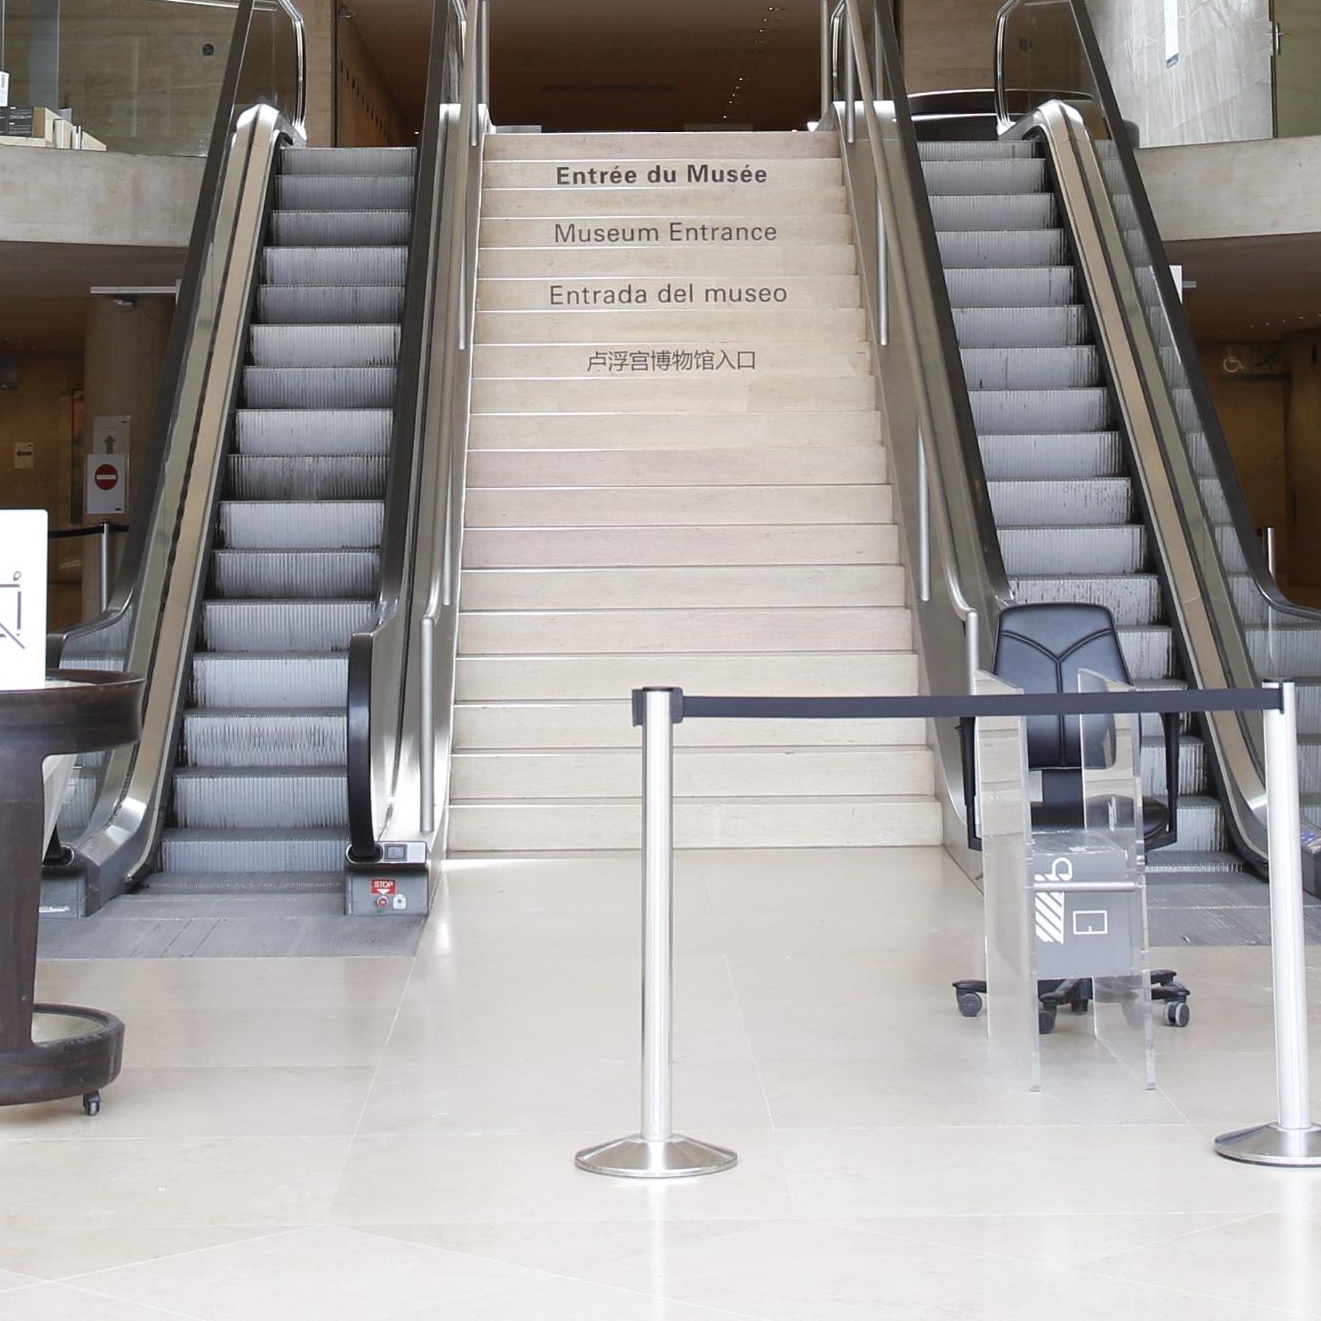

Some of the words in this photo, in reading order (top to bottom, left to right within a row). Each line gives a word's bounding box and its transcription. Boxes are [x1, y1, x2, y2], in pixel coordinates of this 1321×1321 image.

[556, 164, 637, 186] Entrée
[647, 163, 676, 184] du
[687, 162, 768, 184] Musée
[554, 222, 659, 243] Museum
[669, 221, 778, 242] Entrance
[550, 284, 647, 306] Entrada
[657, 282, 693, 304] del
[705, 286, 788, 304] museo
[586, 349, 757, 373] 卢浮宫博物馆入口
[374, 880, 394, 888] STOP
